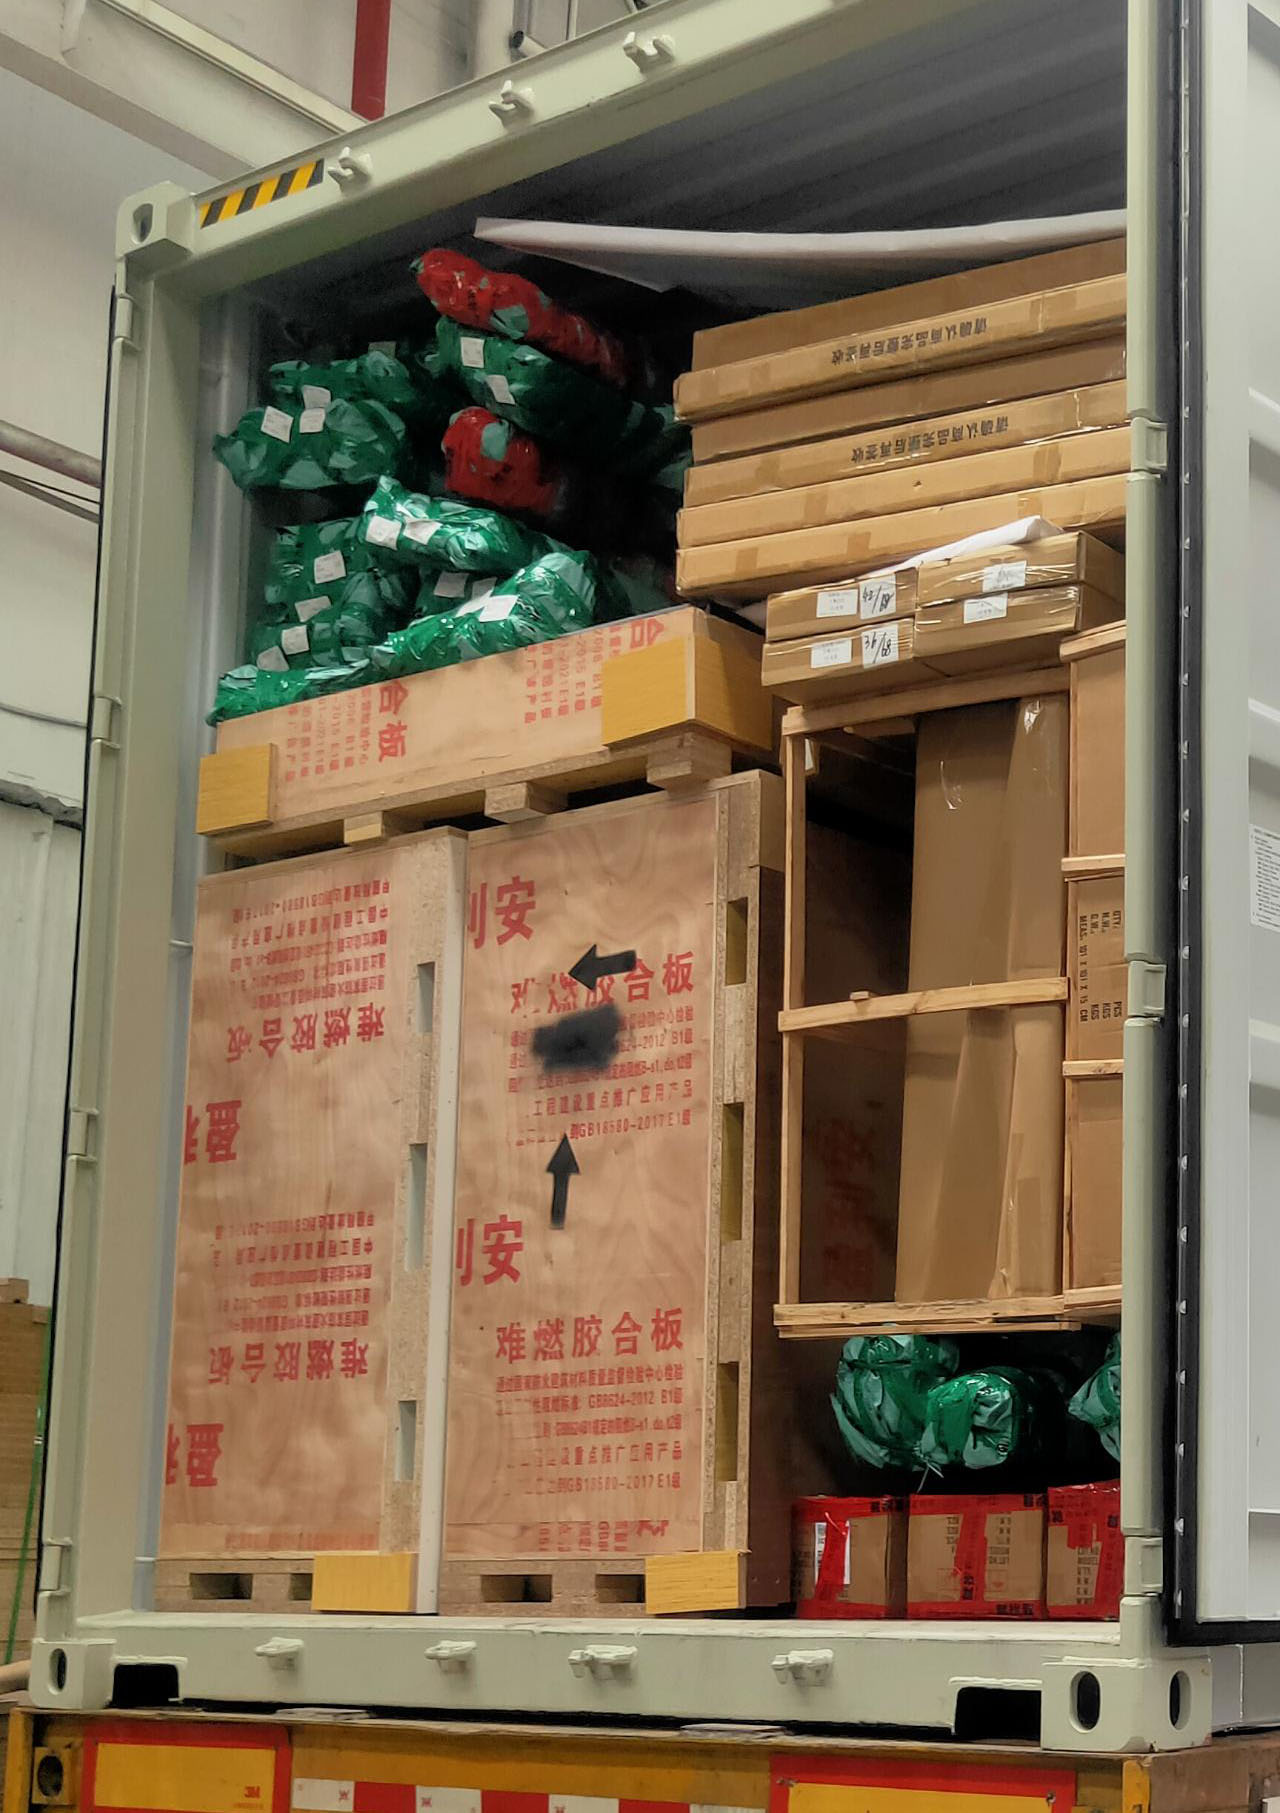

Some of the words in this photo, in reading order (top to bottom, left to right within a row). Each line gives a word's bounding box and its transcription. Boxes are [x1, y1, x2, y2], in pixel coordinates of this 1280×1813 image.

[831, 317, 987, 366] 请确认商品完整后再签收
[851, 416, 1009, 464] 请确认商品完整后再签收
[378, 678, 410, 764] 合板
[495, 1307, 684, 1365] 难燃胶合板
